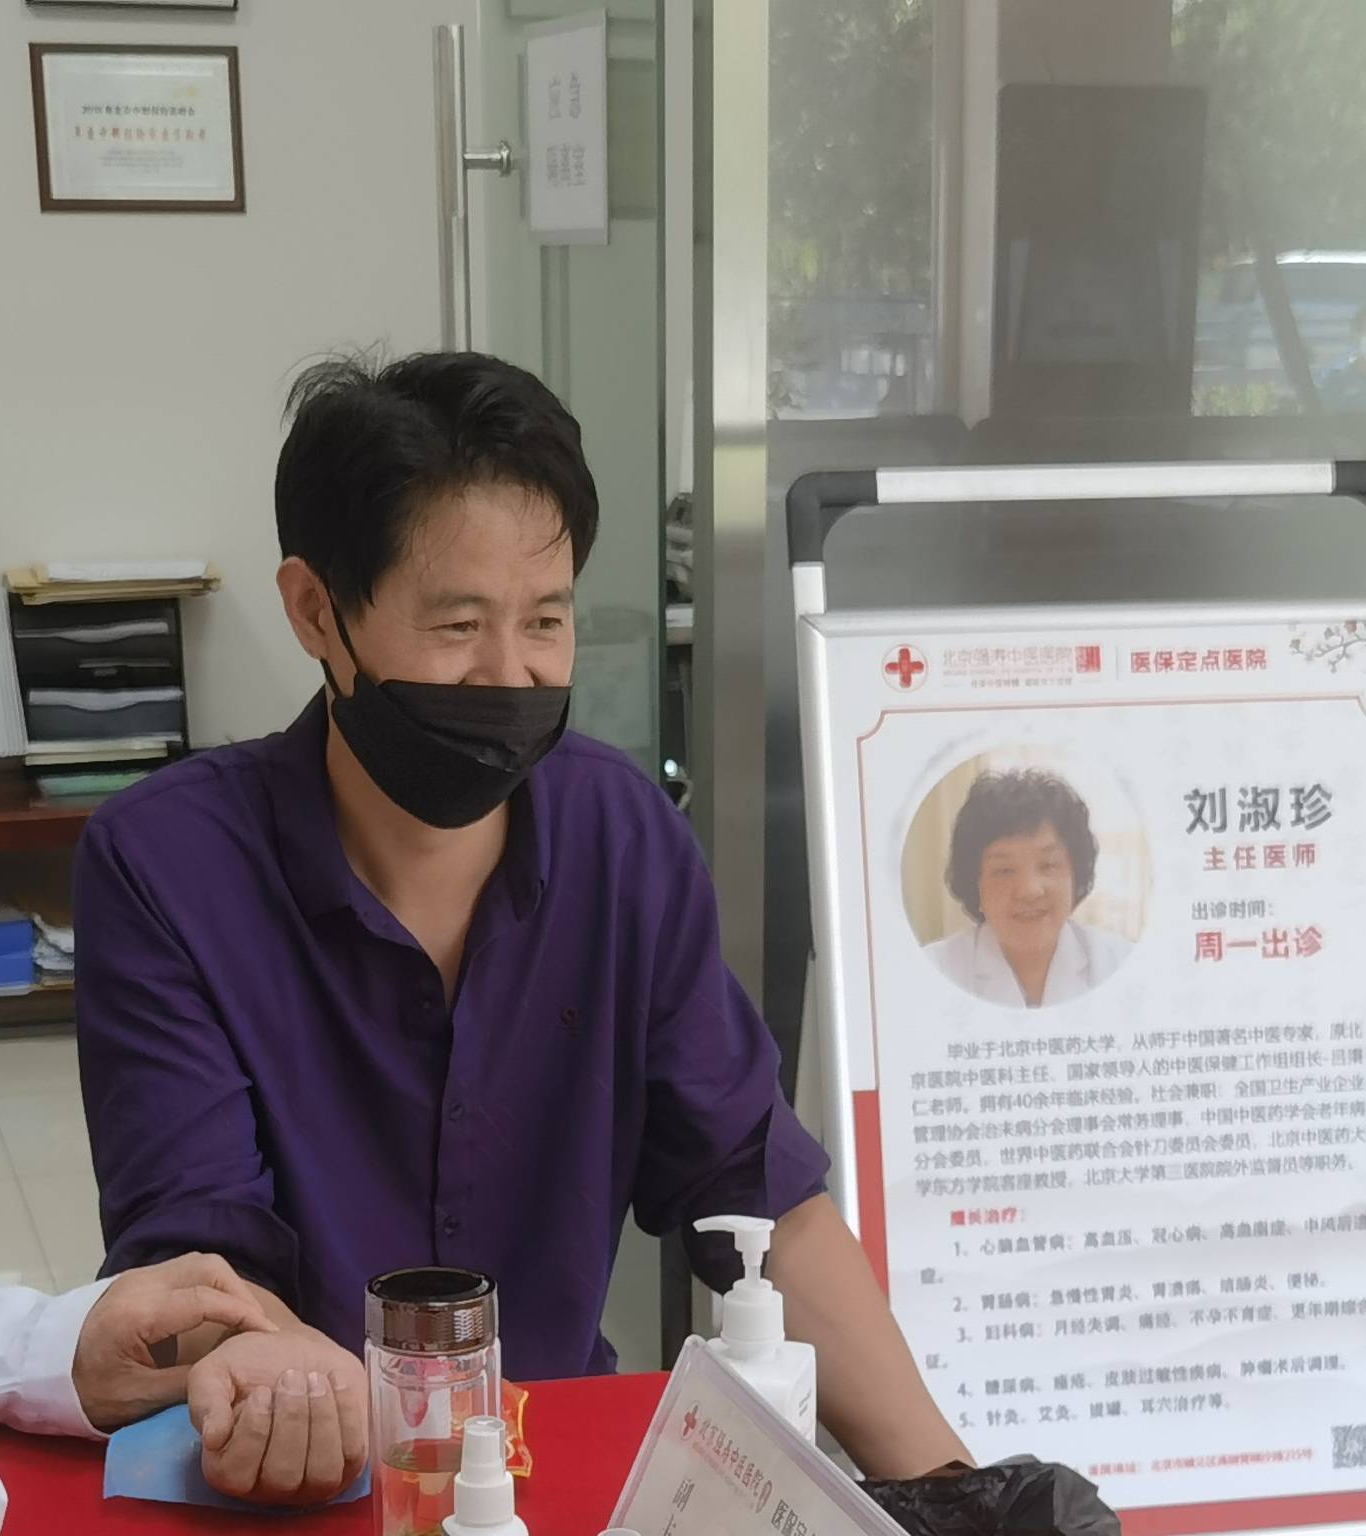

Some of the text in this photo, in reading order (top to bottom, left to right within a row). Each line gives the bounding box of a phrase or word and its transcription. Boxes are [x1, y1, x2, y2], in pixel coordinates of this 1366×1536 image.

[1130, 645, 1268, 676] 医保定点医院
[1184, 782, 1334, 837] 刘淑珍
[1203, 842, 1317, 871] 主任医师
[1194, 926, 1324, 963] 周一出诊
